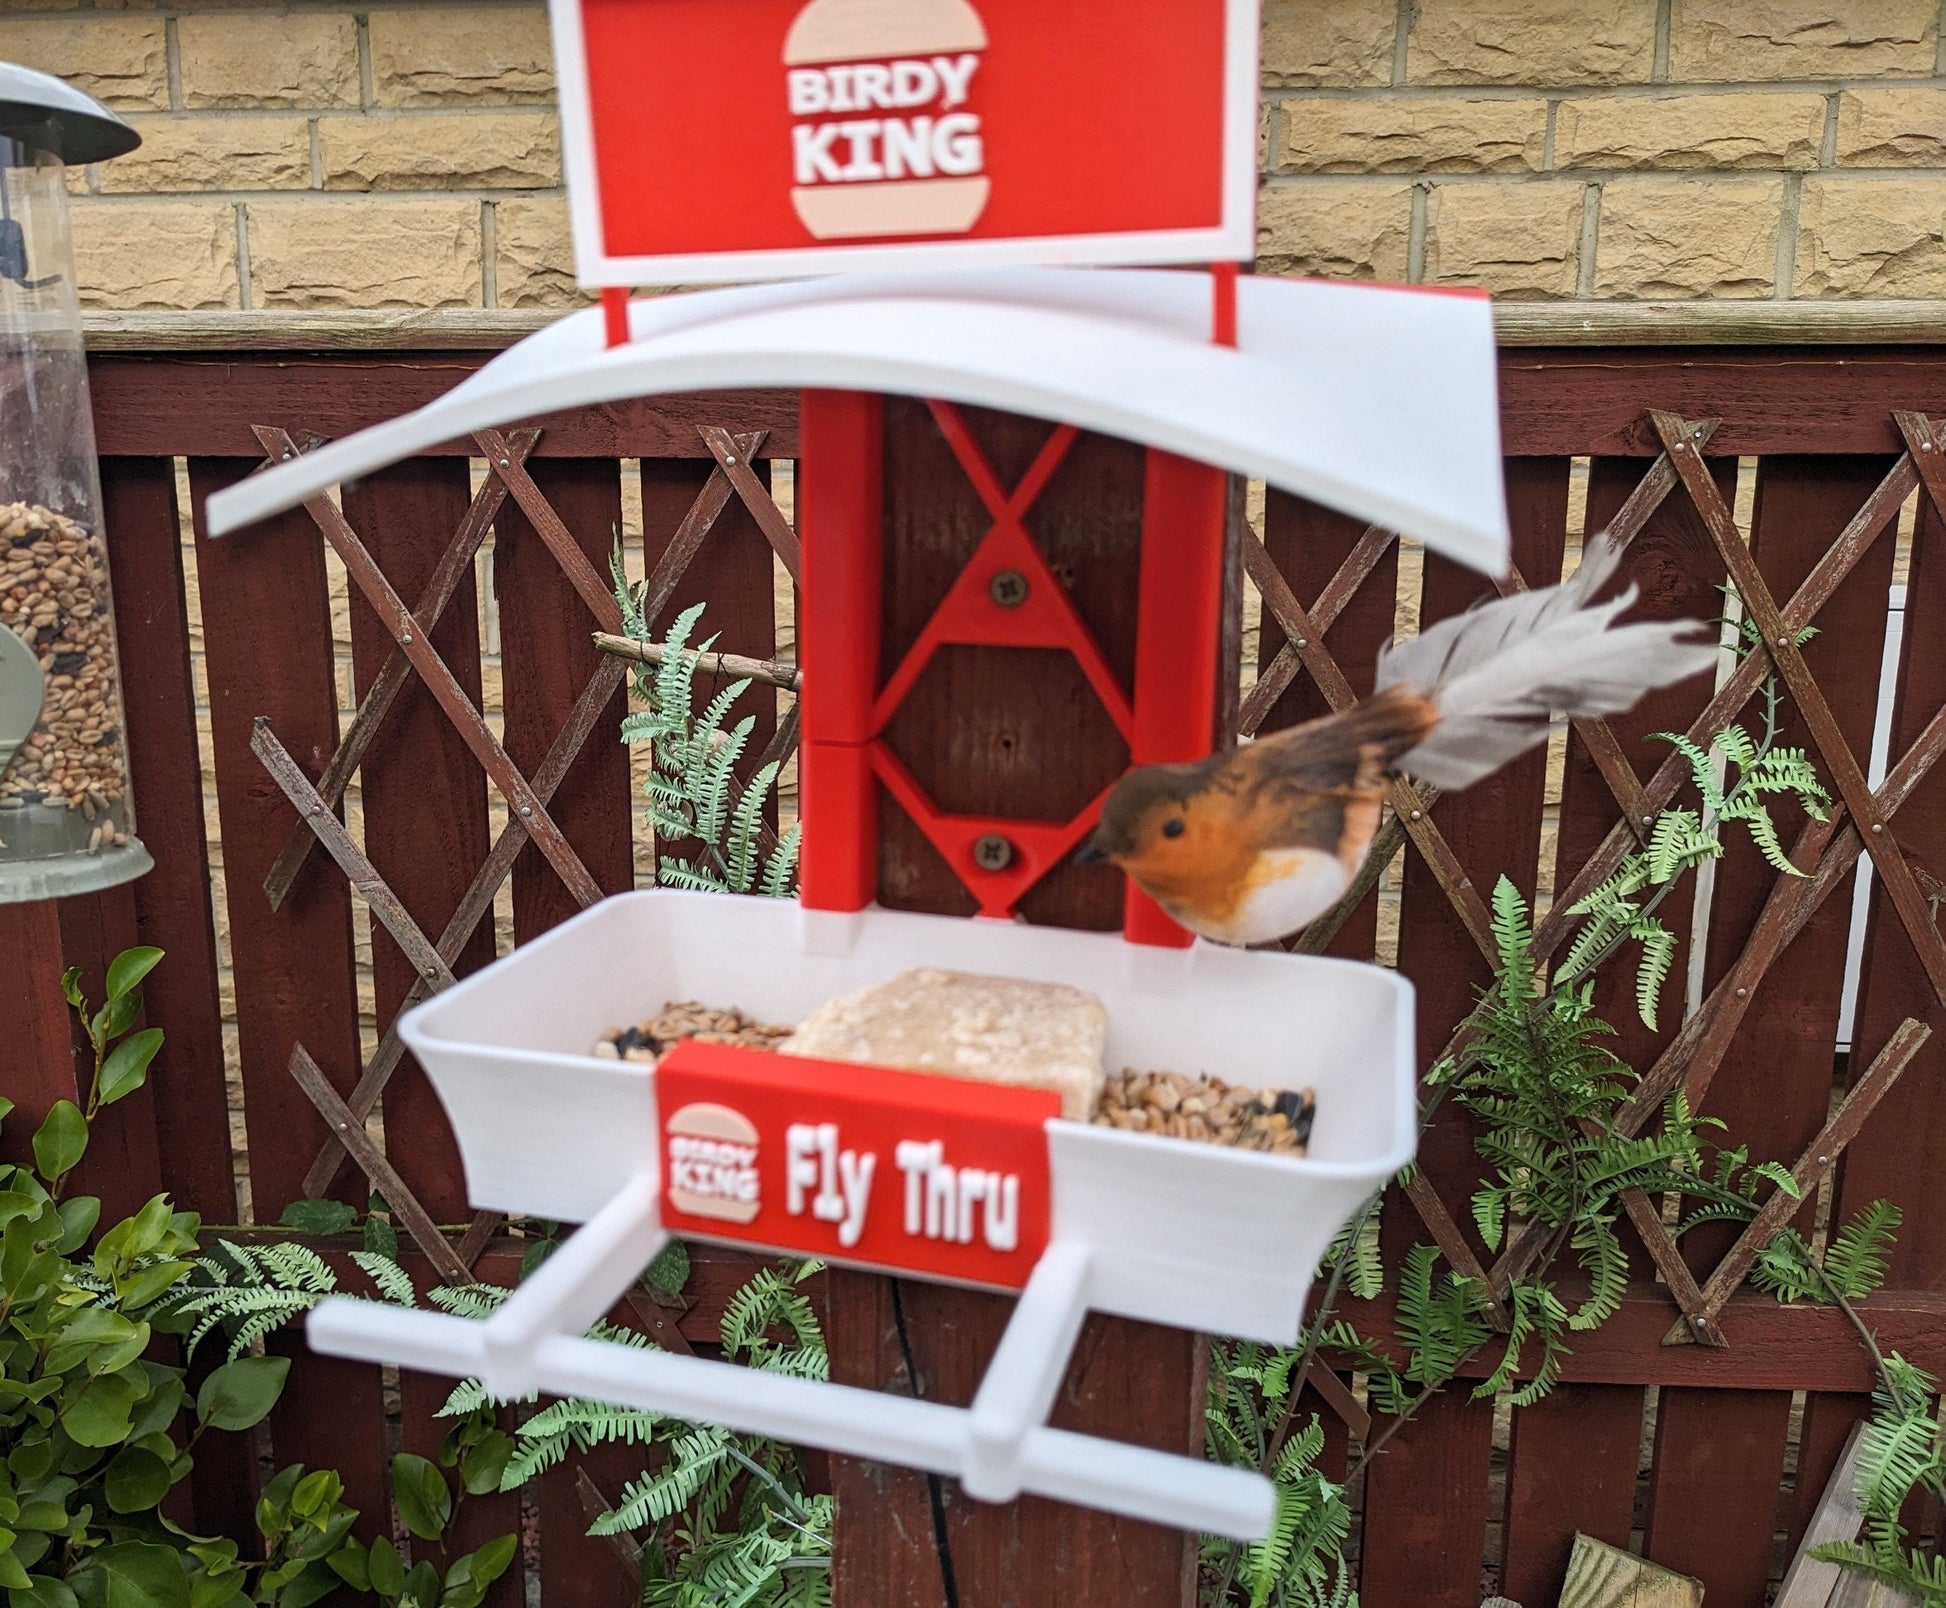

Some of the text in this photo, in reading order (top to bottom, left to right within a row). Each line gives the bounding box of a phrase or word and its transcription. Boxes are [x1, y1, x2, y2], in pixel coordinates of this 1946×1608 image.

[787, 54, 980, 116] BIRDY
[791, 112, 984, 184] KING
[669, 1159, 760, 1202] KING
[785, 1122, 1020, 1252] Fly Thru
